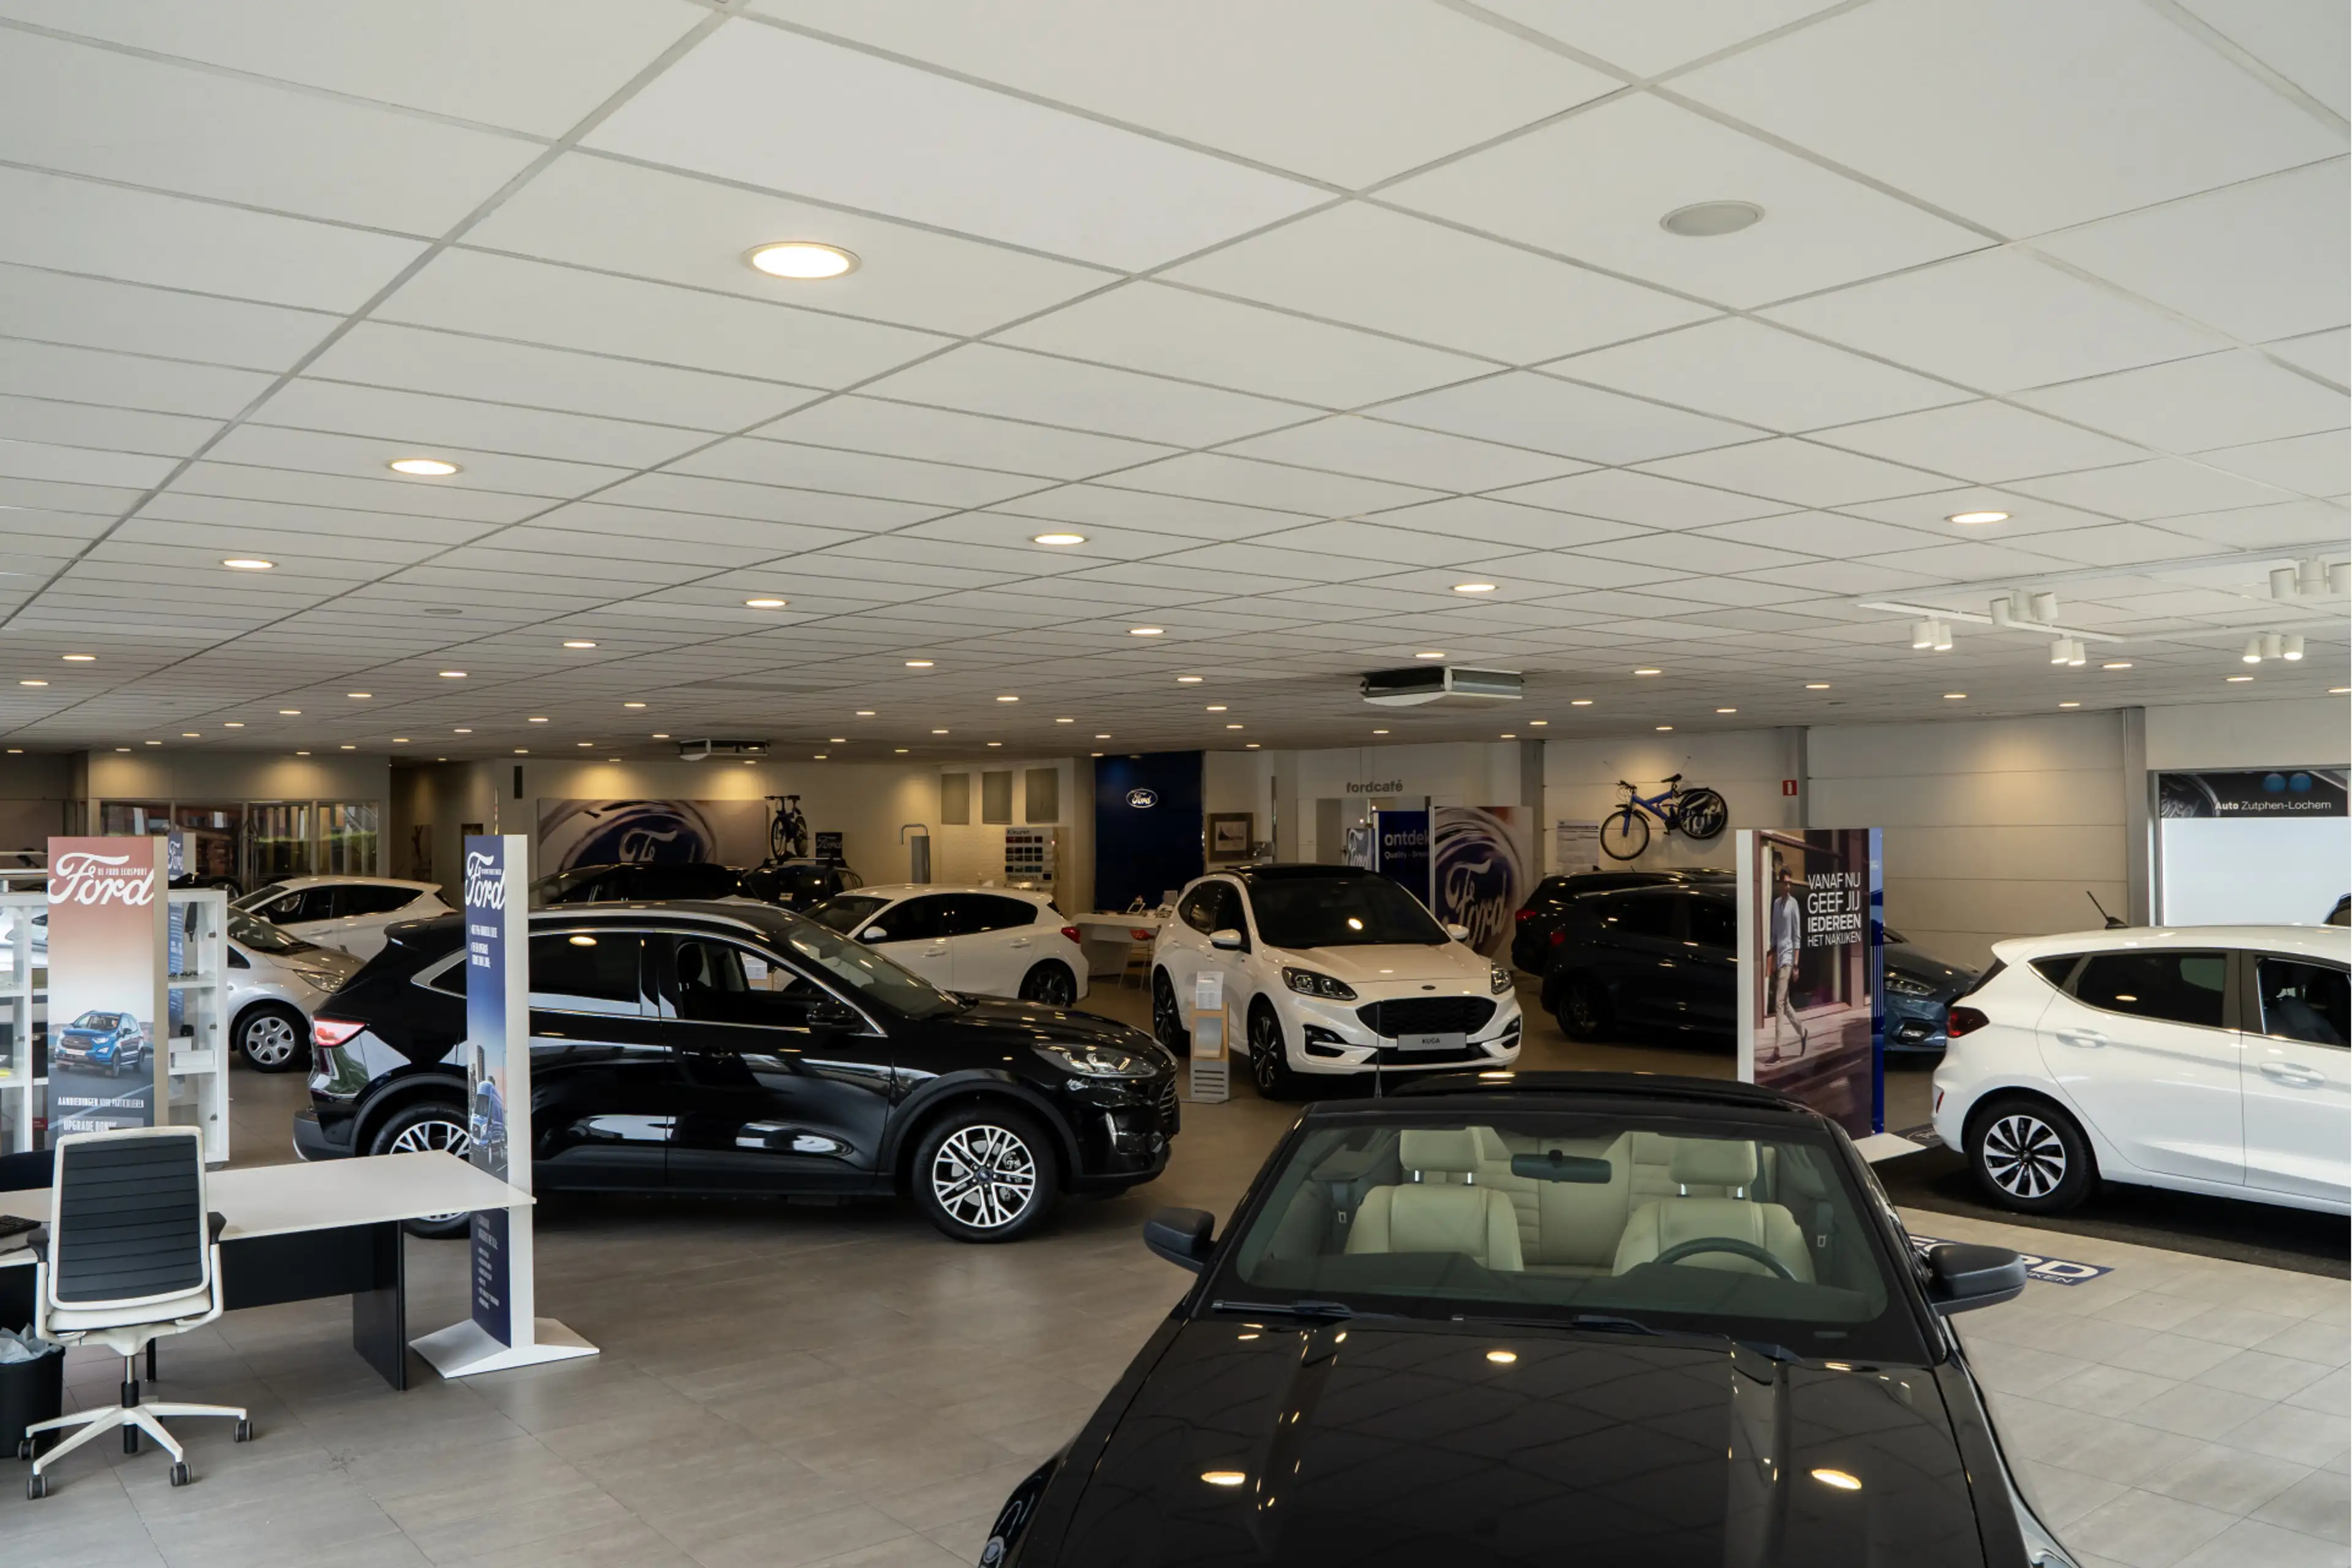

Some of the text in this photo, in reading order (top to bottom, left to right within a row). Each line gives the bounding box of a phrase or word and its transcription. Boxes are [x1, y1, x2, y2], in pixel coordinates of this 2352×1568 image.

[1346, 779, 1403, 793] fordcafé
[2215, 800, 2331, 812] Auto Zutphen-Lochem
[168, 840, 184, 870] Ford
[1348, 828, 1370, 870] Ford
[48, 852, 154, 906] Ford
[465, 851, 506, 910] Ford
[1807, 872, 1861, 890] VANAF NU
[1442, 859, 1507, 949] Ford
[1807, 891, 1860, 914] GEEF JIJ
[1807, 913, 1861, 933] IEDEREEN
[1807, 931, 1861, 948] HET NAKIJKEN
[63, 1119, 94, 1131] UPGRADE
